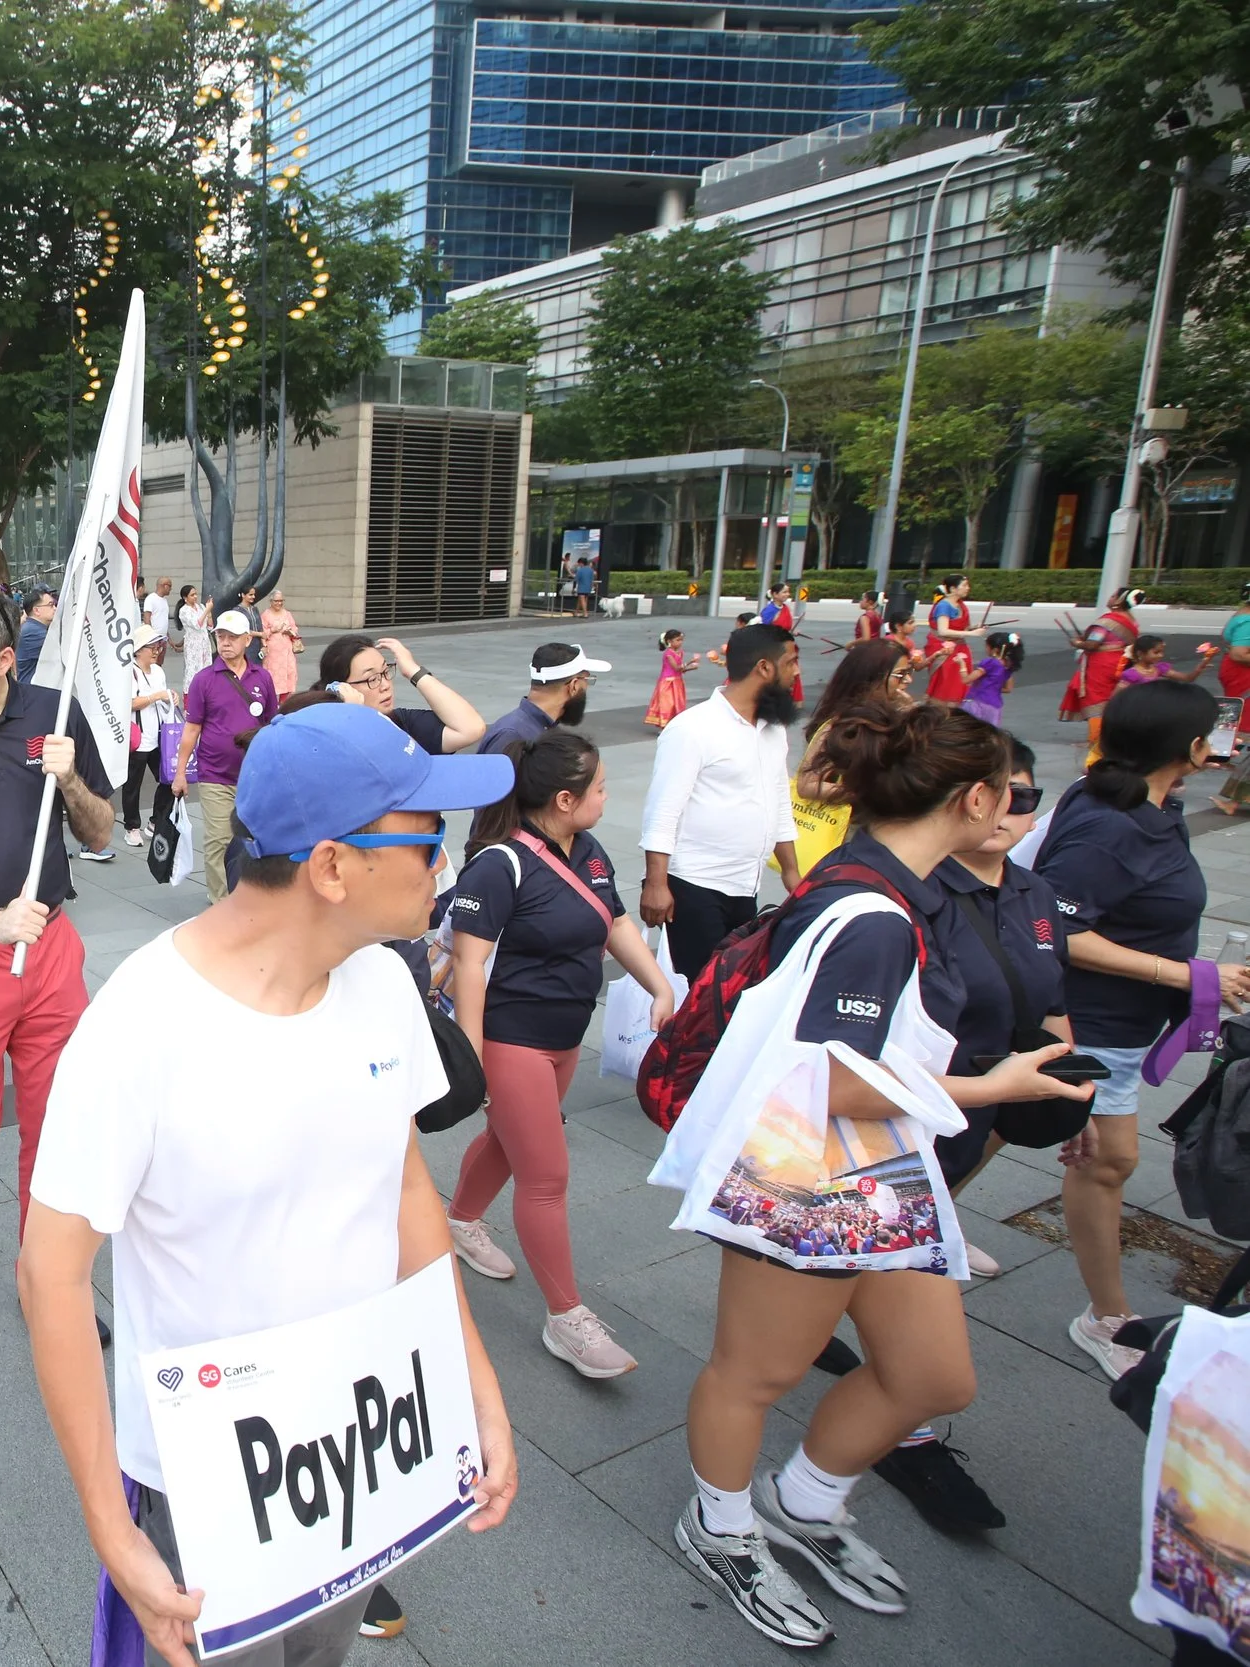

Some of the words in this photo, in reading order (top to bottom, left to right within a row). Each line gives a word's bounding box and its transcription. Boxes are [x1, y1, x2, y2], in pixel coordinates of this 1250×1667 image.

[93, 669, 125, 744] Leadership
[200, 1369, 219, 1383] SG
[223, 1363, 257, 1378] Cares
[233, 1348, 434, 1551] PayPal
[319, 1585, 329, 1603] To
[363, 1562, 378, 1579] Love
